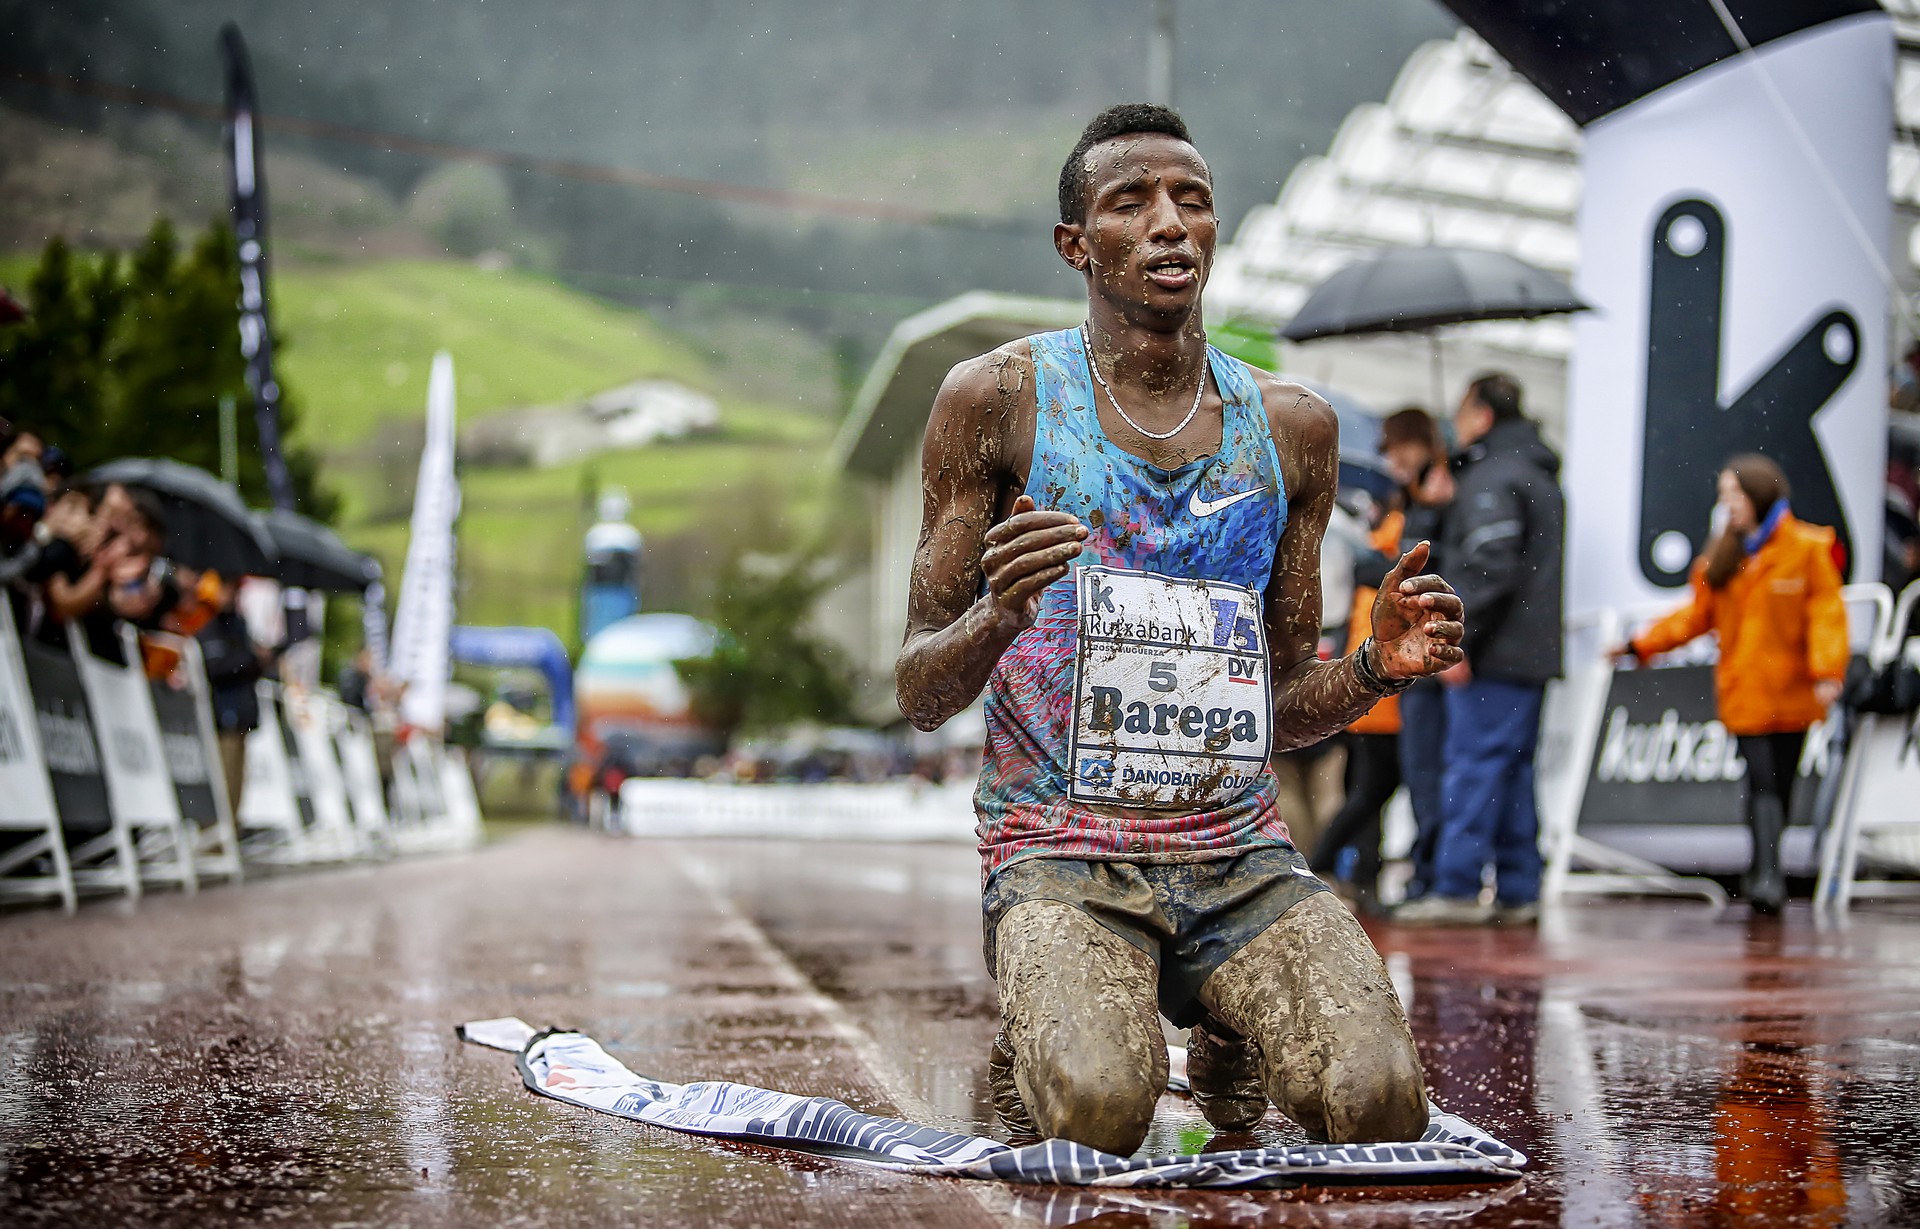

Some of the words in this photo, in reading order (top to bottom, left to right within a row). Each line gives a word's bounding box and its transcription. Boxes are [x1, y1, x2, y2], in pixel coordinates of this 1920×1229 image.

[1210, 598, 1259, 651] 75
[1091, 643, 1117, 653] ROSS
[1147, 662, 1178, 693] 5
[1228, 657, 1257, 679] DV
[1088, 685, 1259, 751] Barega
[1597, 706, 1834, 782] kutxak
[1122, 768, 1254, 789] DANOBATOUP
